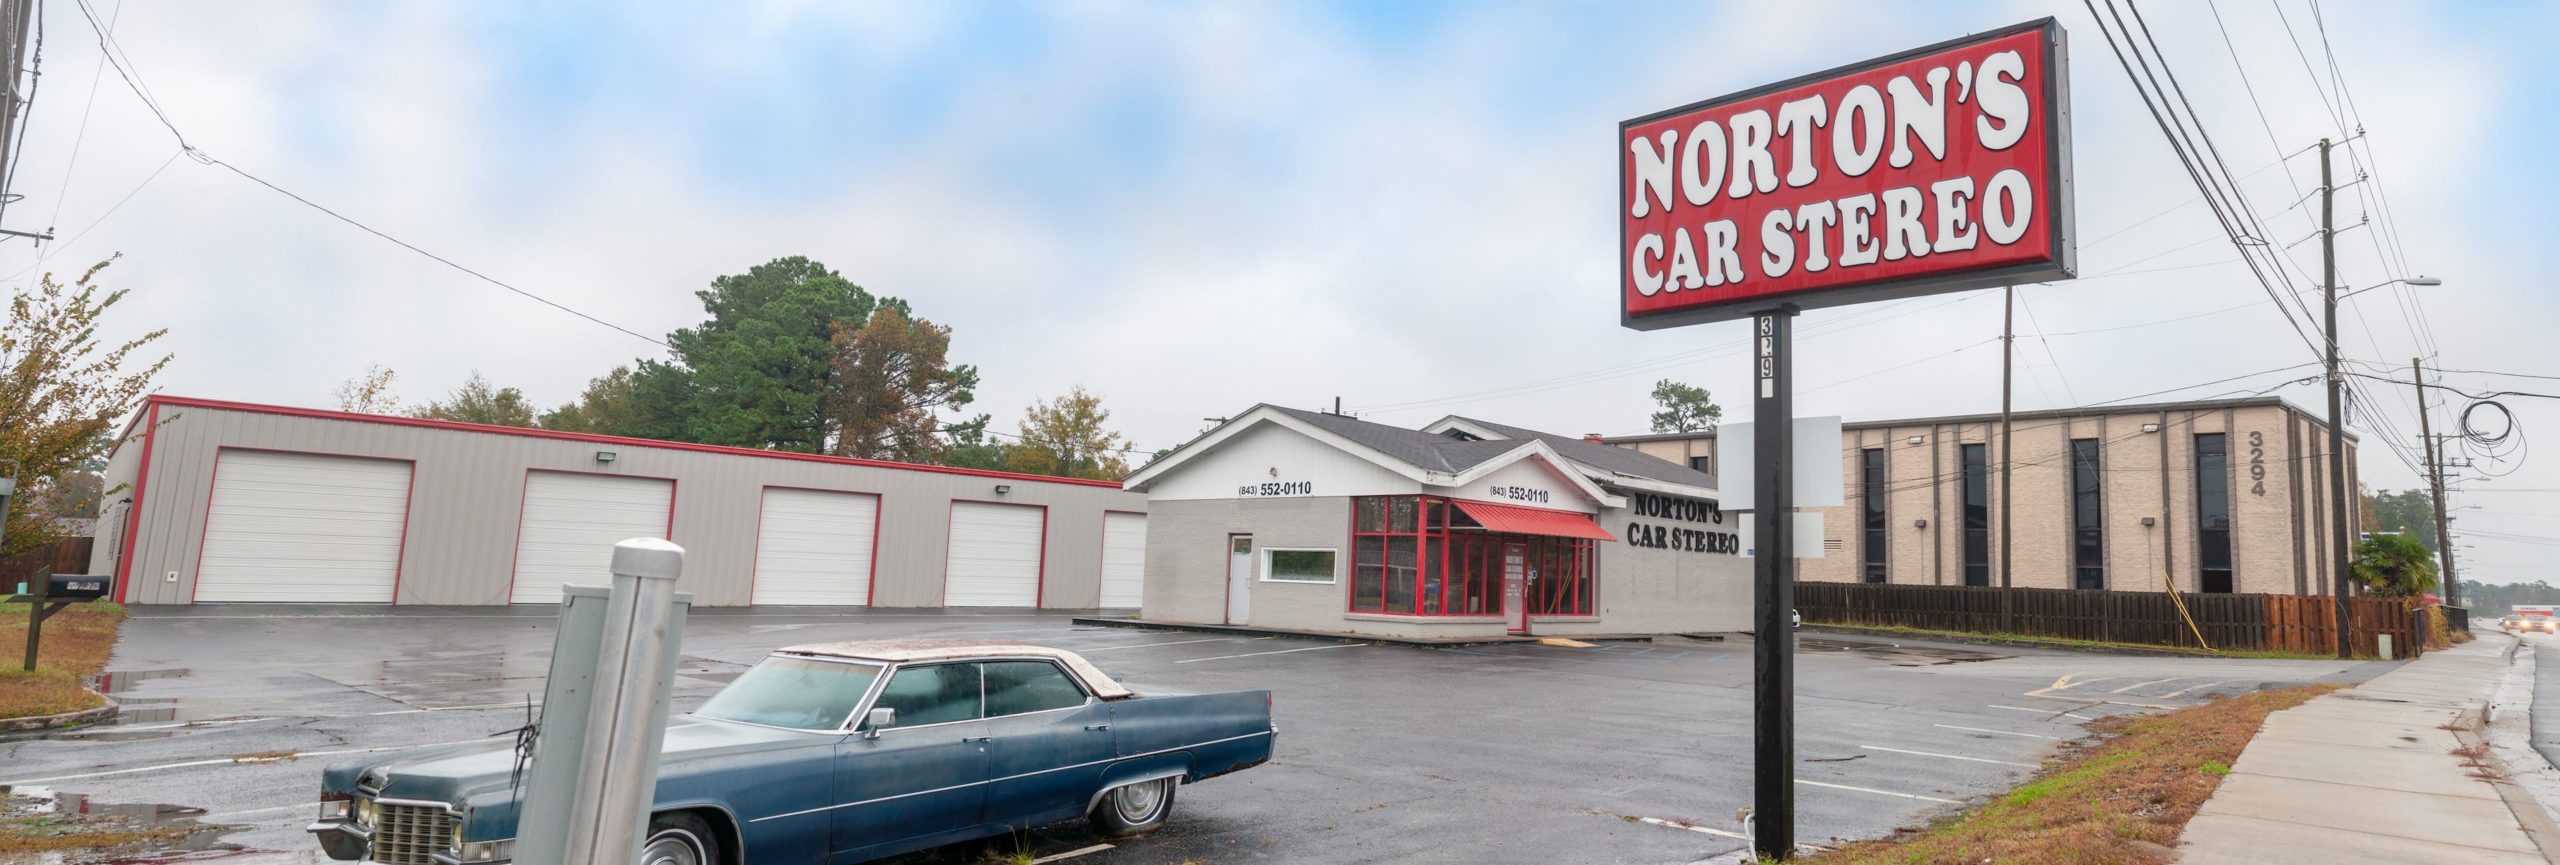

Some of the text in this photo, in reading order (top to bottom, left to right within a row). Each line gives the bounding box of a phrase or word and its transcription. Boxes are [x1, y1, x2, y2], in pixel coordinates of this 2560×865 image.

[1631, 49, 2030, 218] NORTON'S
[1632, 168, 2033, 296] CAR STEREO
[2249, 430, 2266, 497] 3294
[1239, 481, 1312, 497] (843) 552-0110
[1490, 485, 1549, 503] (843) 552-0110
[1634, 492, 1723, 525] NORTON'S
[1627, 521, 1739, 555] CAR STEREO
